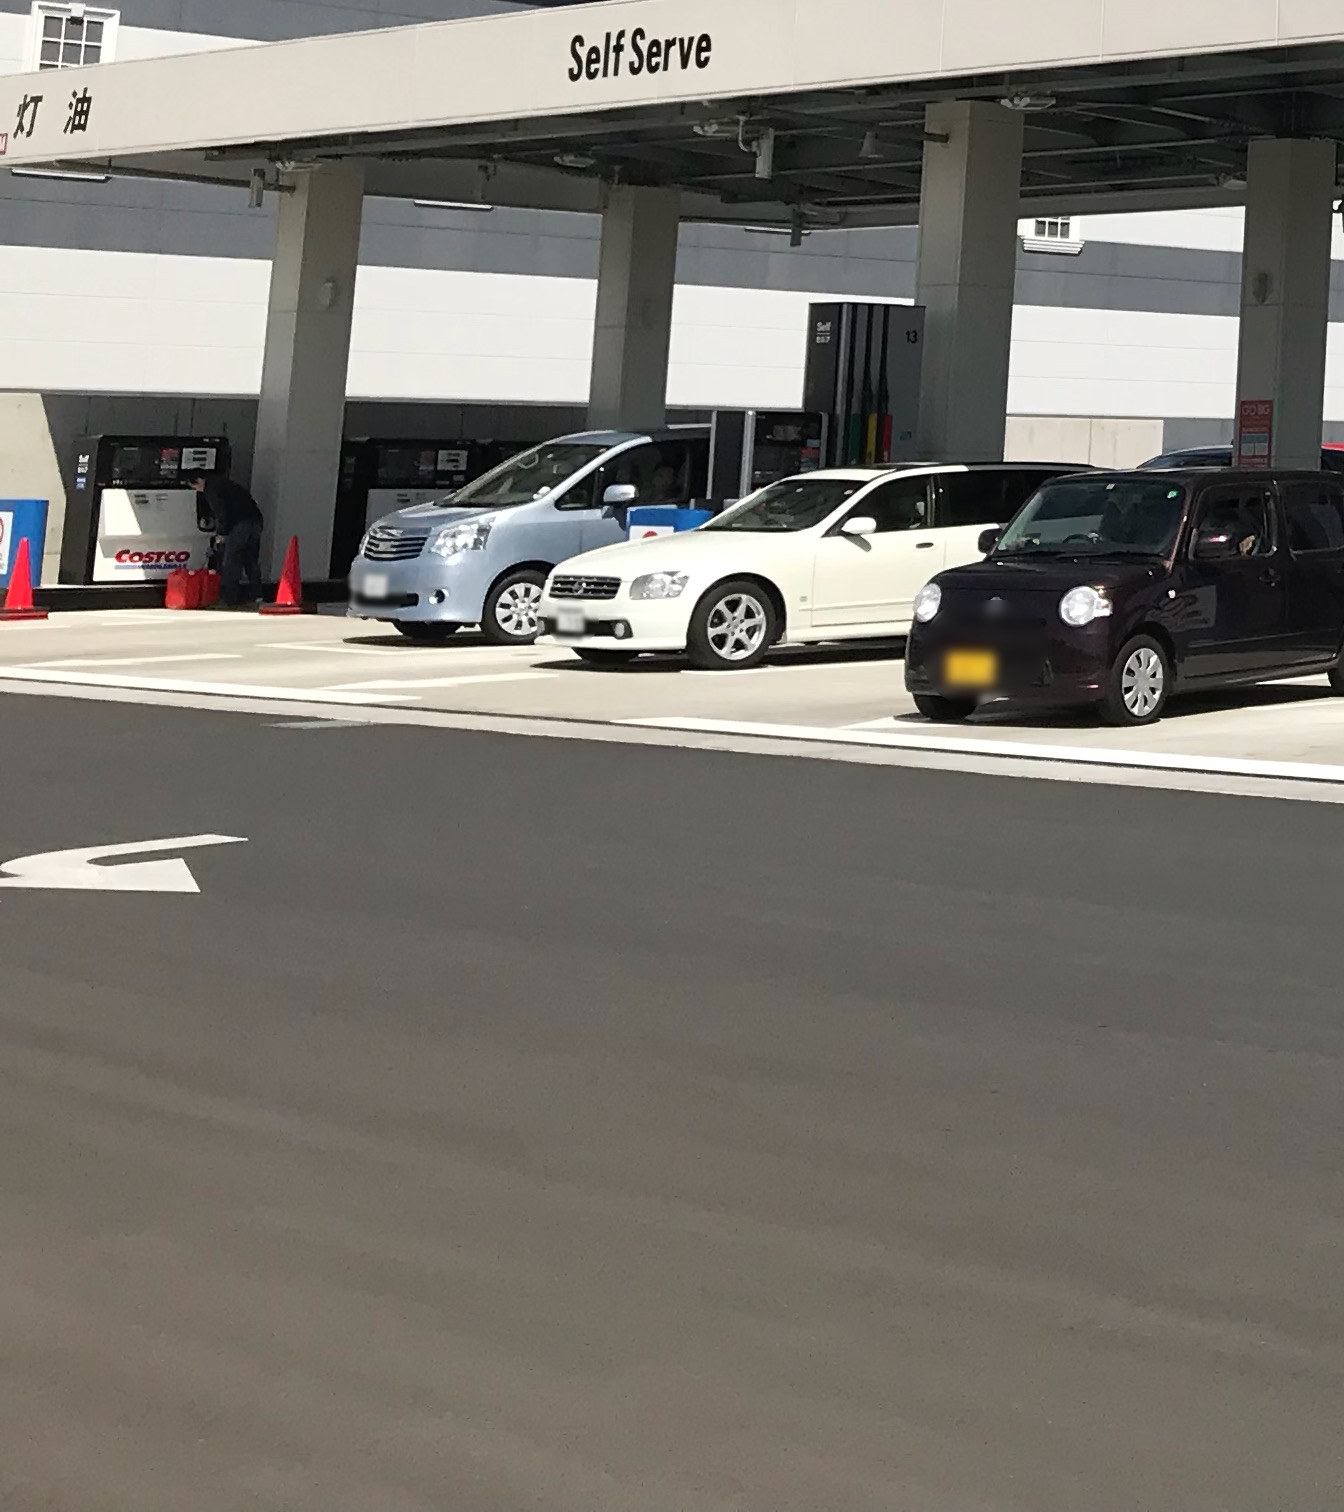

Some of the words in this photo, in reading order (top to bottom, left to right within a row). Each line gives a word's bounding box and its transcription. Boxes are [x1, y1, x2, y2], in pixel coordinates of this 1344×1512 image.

[568, 29, 626, 82] Self
[629, 27, 712, 75] Serve
[905, 330, 918, 344] 13
[115, 549, 190, 564] COSTCO
